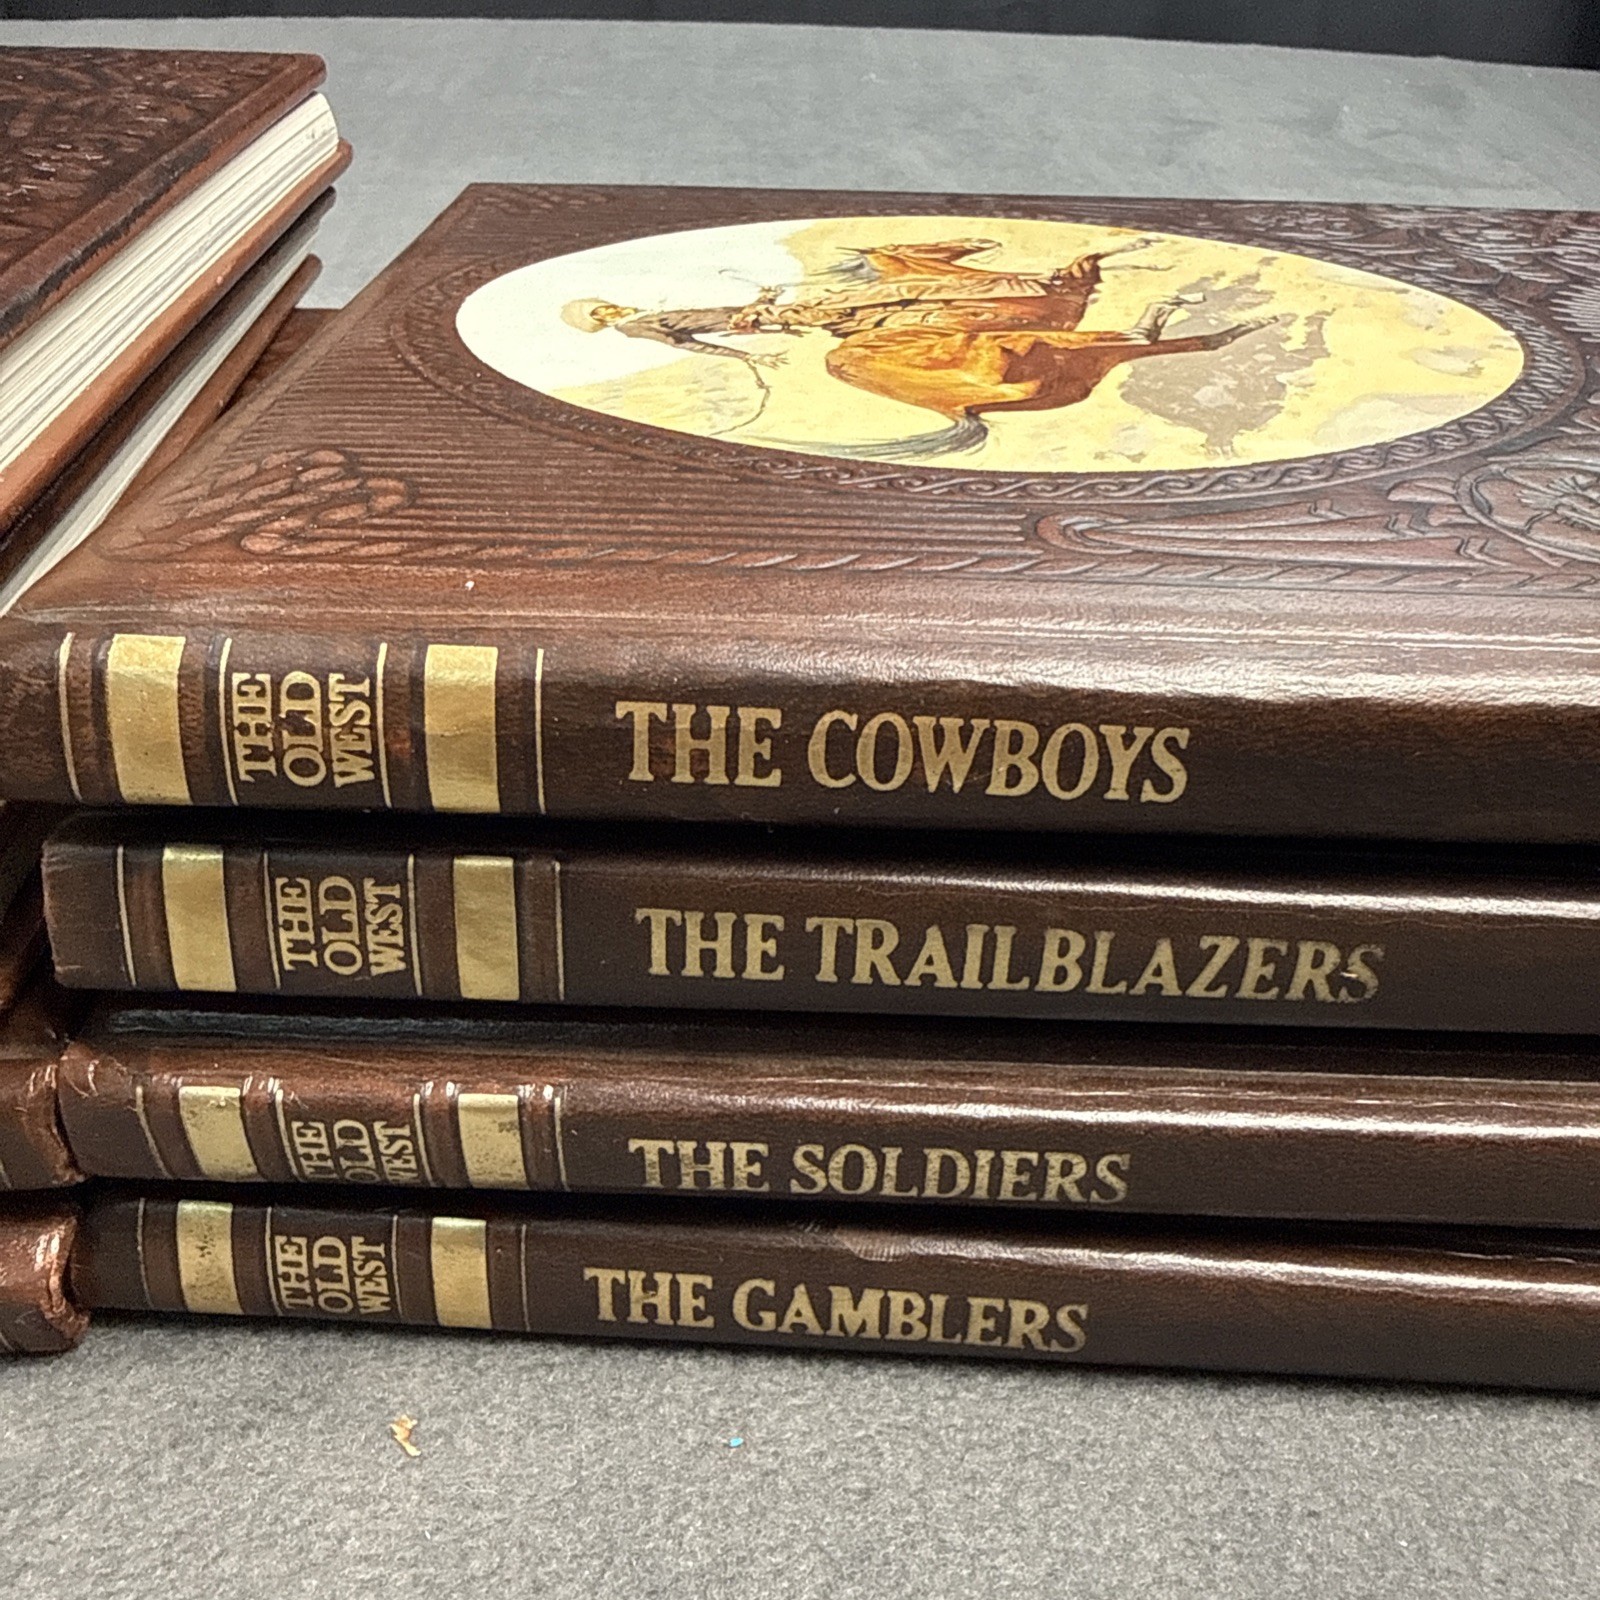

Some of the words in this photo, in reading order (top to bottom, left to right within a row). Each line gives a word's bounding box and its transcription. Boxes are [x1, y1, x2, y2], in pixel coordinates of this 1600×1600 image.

[232, 672, 277, 783] THE
[279, 671, 327, 787] OLD
[328, 672, 375, 788] WEST
[615, 700, 782, 787] THE
[807, 710, 1191, 802] COWBOYS
[275, 877, 318, 971] THE
[318, 876, 363, 975] OLD
[363, 877, 406, 976] WEST
[634, 907, 784, 981] THE
[805, 916, 1386, 1003] TRAILBLAZERS
[291, 1121, 340, 1180] THE
[333, 1119, 382, 1183] OLD
[373, 1121, 421, 1185] WEST
[627, 1138, 770, 1193] THE
[790, 1143, 1132, 1205] SOLDIERS
[274, 1235, 315, 1310] THE
[312, 1235, 353, 1314] OLD
[351, 1236, 391, 1315] WEST
[583, 1266, 715, 1329] THE
[732, 1277, 1090, 1354] GAMBLERS
